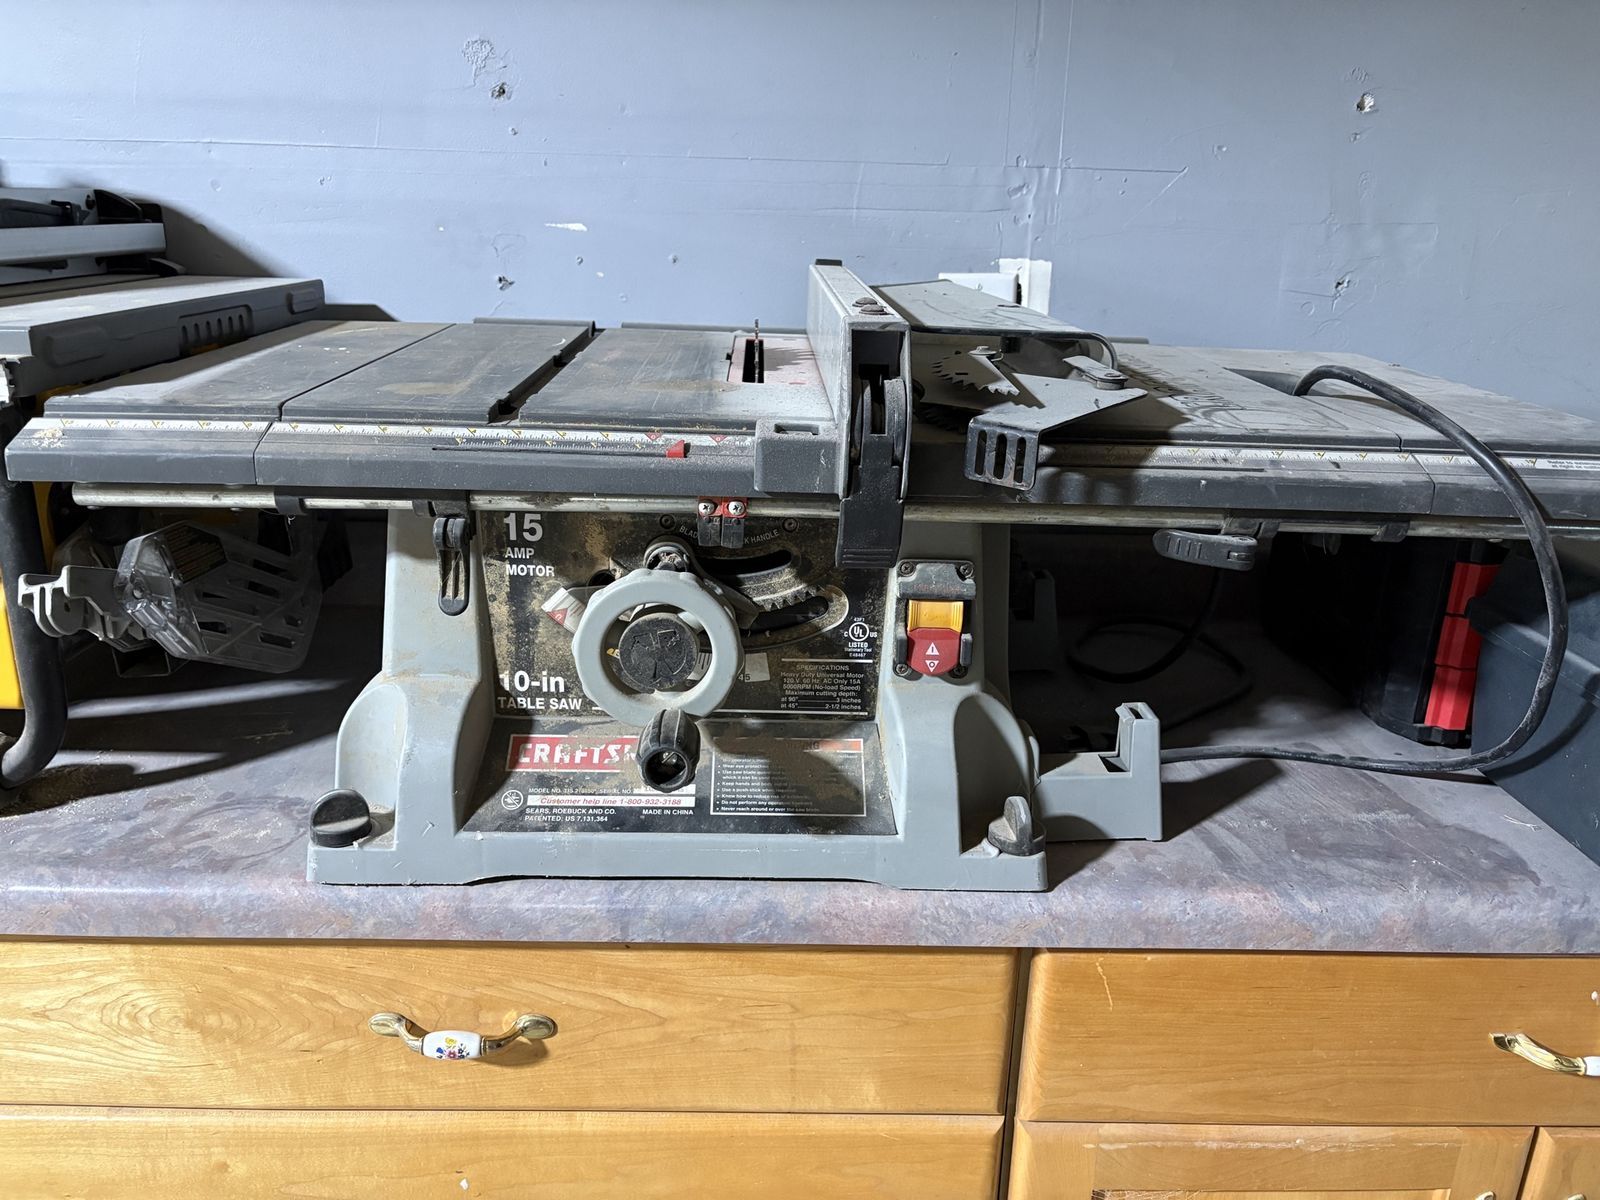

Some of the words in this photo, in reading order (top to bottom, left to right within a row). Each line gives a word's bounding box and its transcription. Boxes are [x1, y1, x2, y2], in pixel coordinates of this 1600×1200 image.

[503, 512, 543, 542] 15
[680, 524, 698, 538] BLAD
[751, 528, 780, 543] HANDLE
[505, 547, 535, 559] AMP
[506, 564, 555, 577] MOTOR
[499, 670, 565, 693] 10-in
[498, 697, 546, 710] TABLE
[550, 697, 582, 710] SAW
[541, 797, 580, 805] Customer
[583, 798, 600, 806] help
[620, 798, 682, 806] 1-800-932-3188
